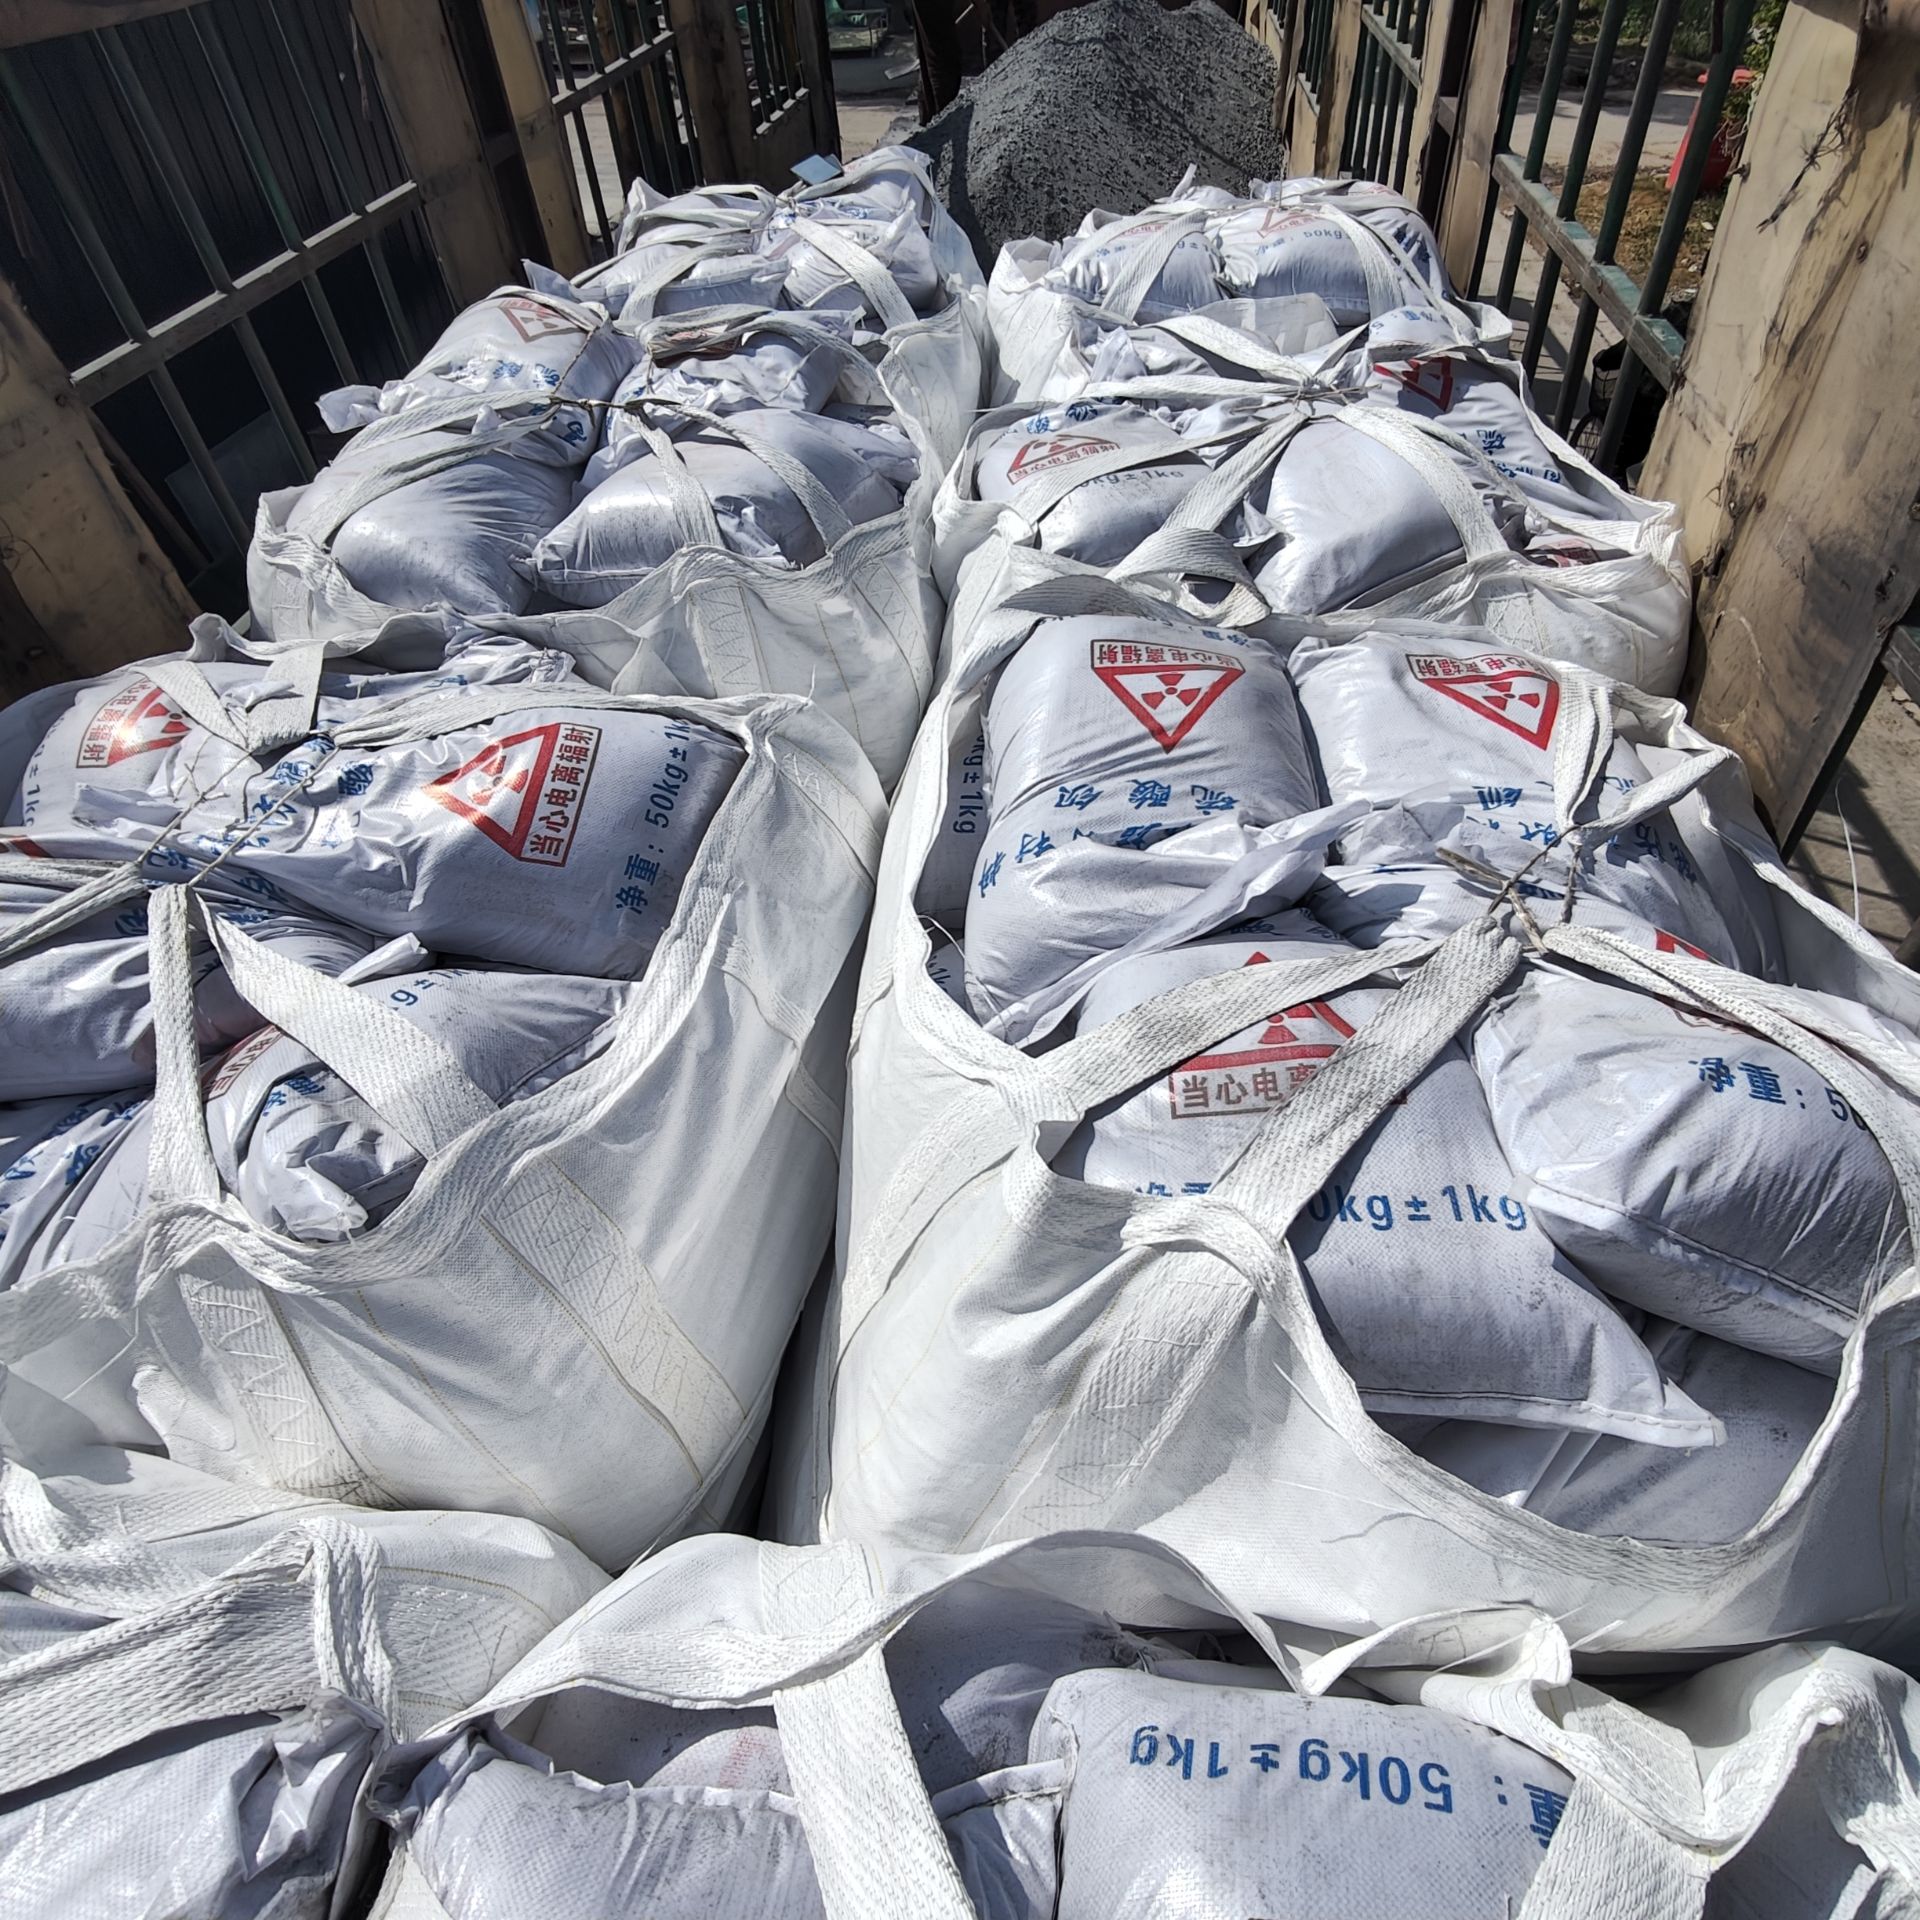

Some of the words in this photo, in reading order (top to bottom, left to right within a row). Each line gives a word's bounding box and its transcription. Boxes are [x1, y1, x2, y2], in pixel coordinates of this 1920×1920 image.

[1099, 642, 1236, 671] 当心电离辐射
[529, 726, 593, 857] 当心电离辐射
[645, 719, 691, 829] 50kg±1k
